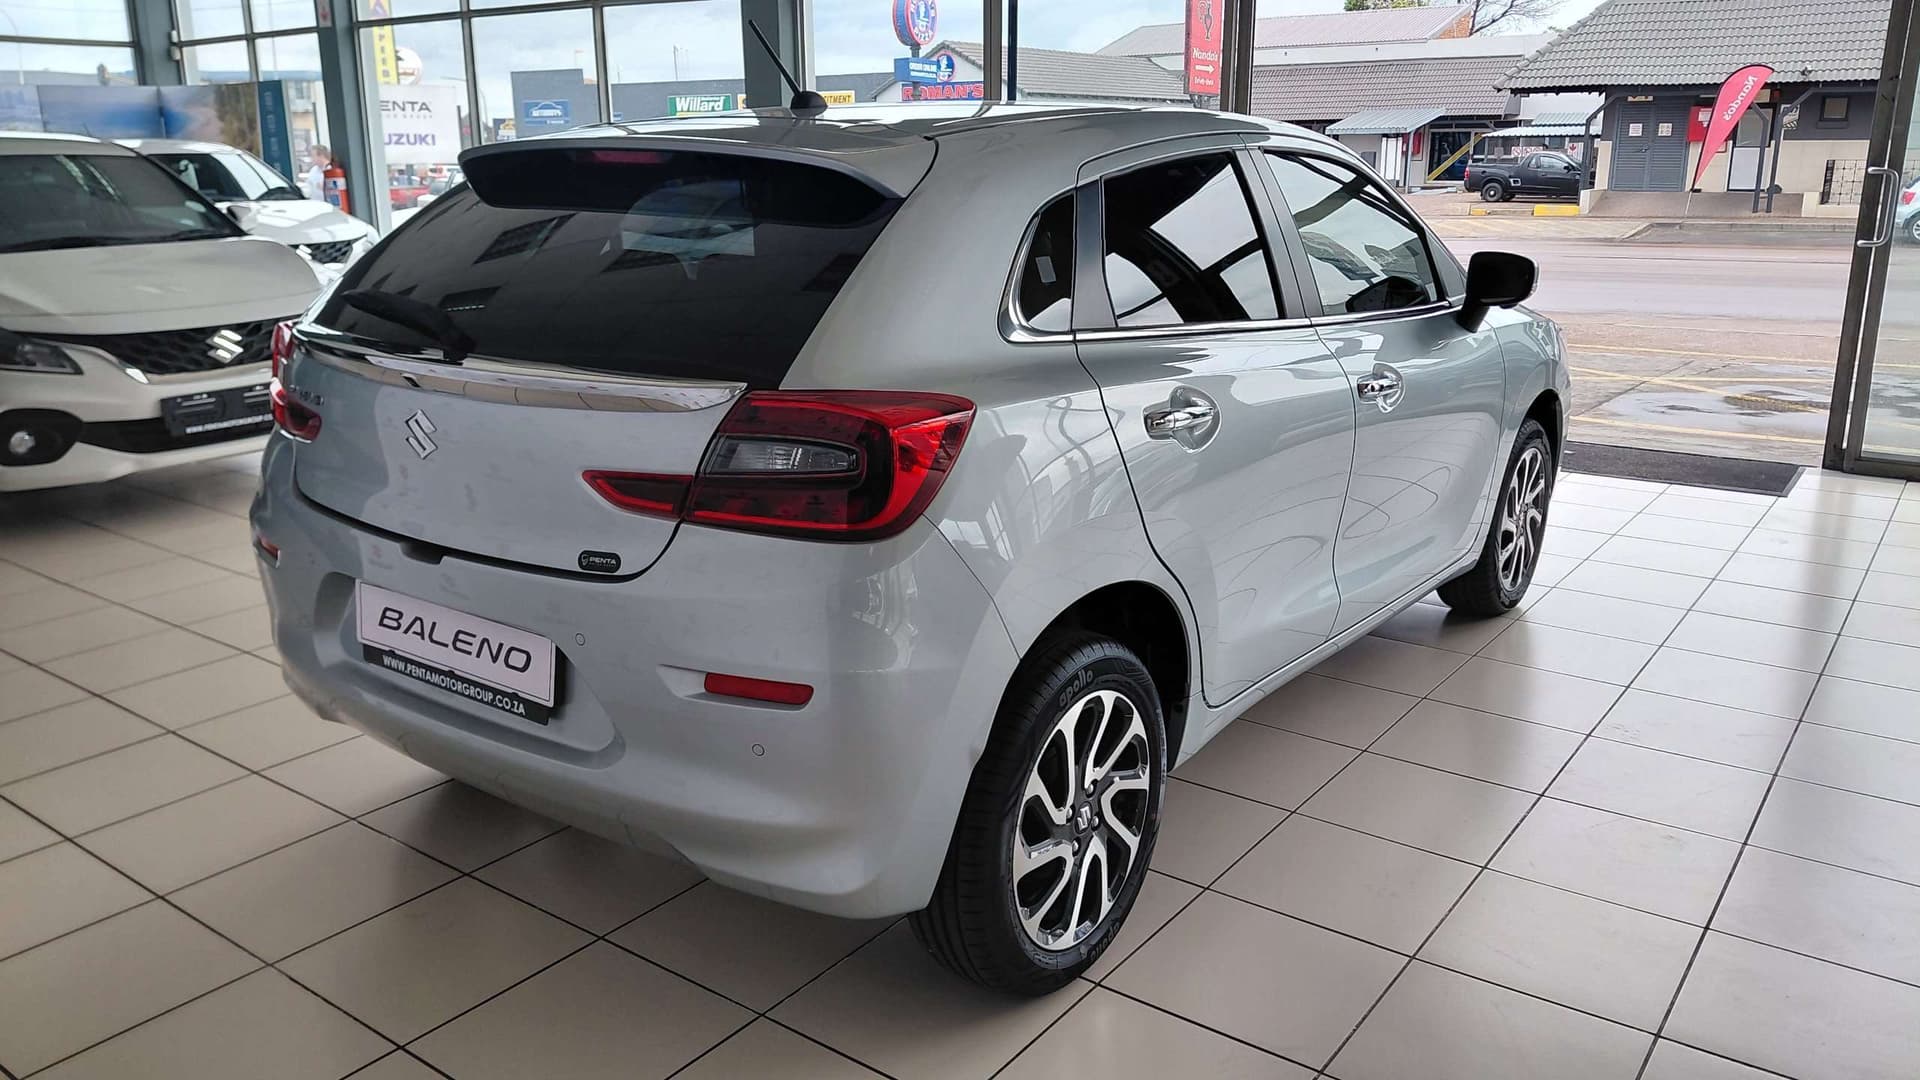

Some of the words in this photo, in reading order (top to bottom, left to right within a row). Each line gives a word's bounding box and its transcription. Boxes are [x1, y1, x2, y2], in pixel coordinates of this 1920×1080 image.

[1193, 48, 1218, 61] Nando's
[676, 96, 724, 112] Willard
[378, 606, 532, 674] BALENO
[382, 654, 526, 716] WWW.PENTAMOTORGROUP.CO.ZA
[1060, 669, 1094, 710] apollo
